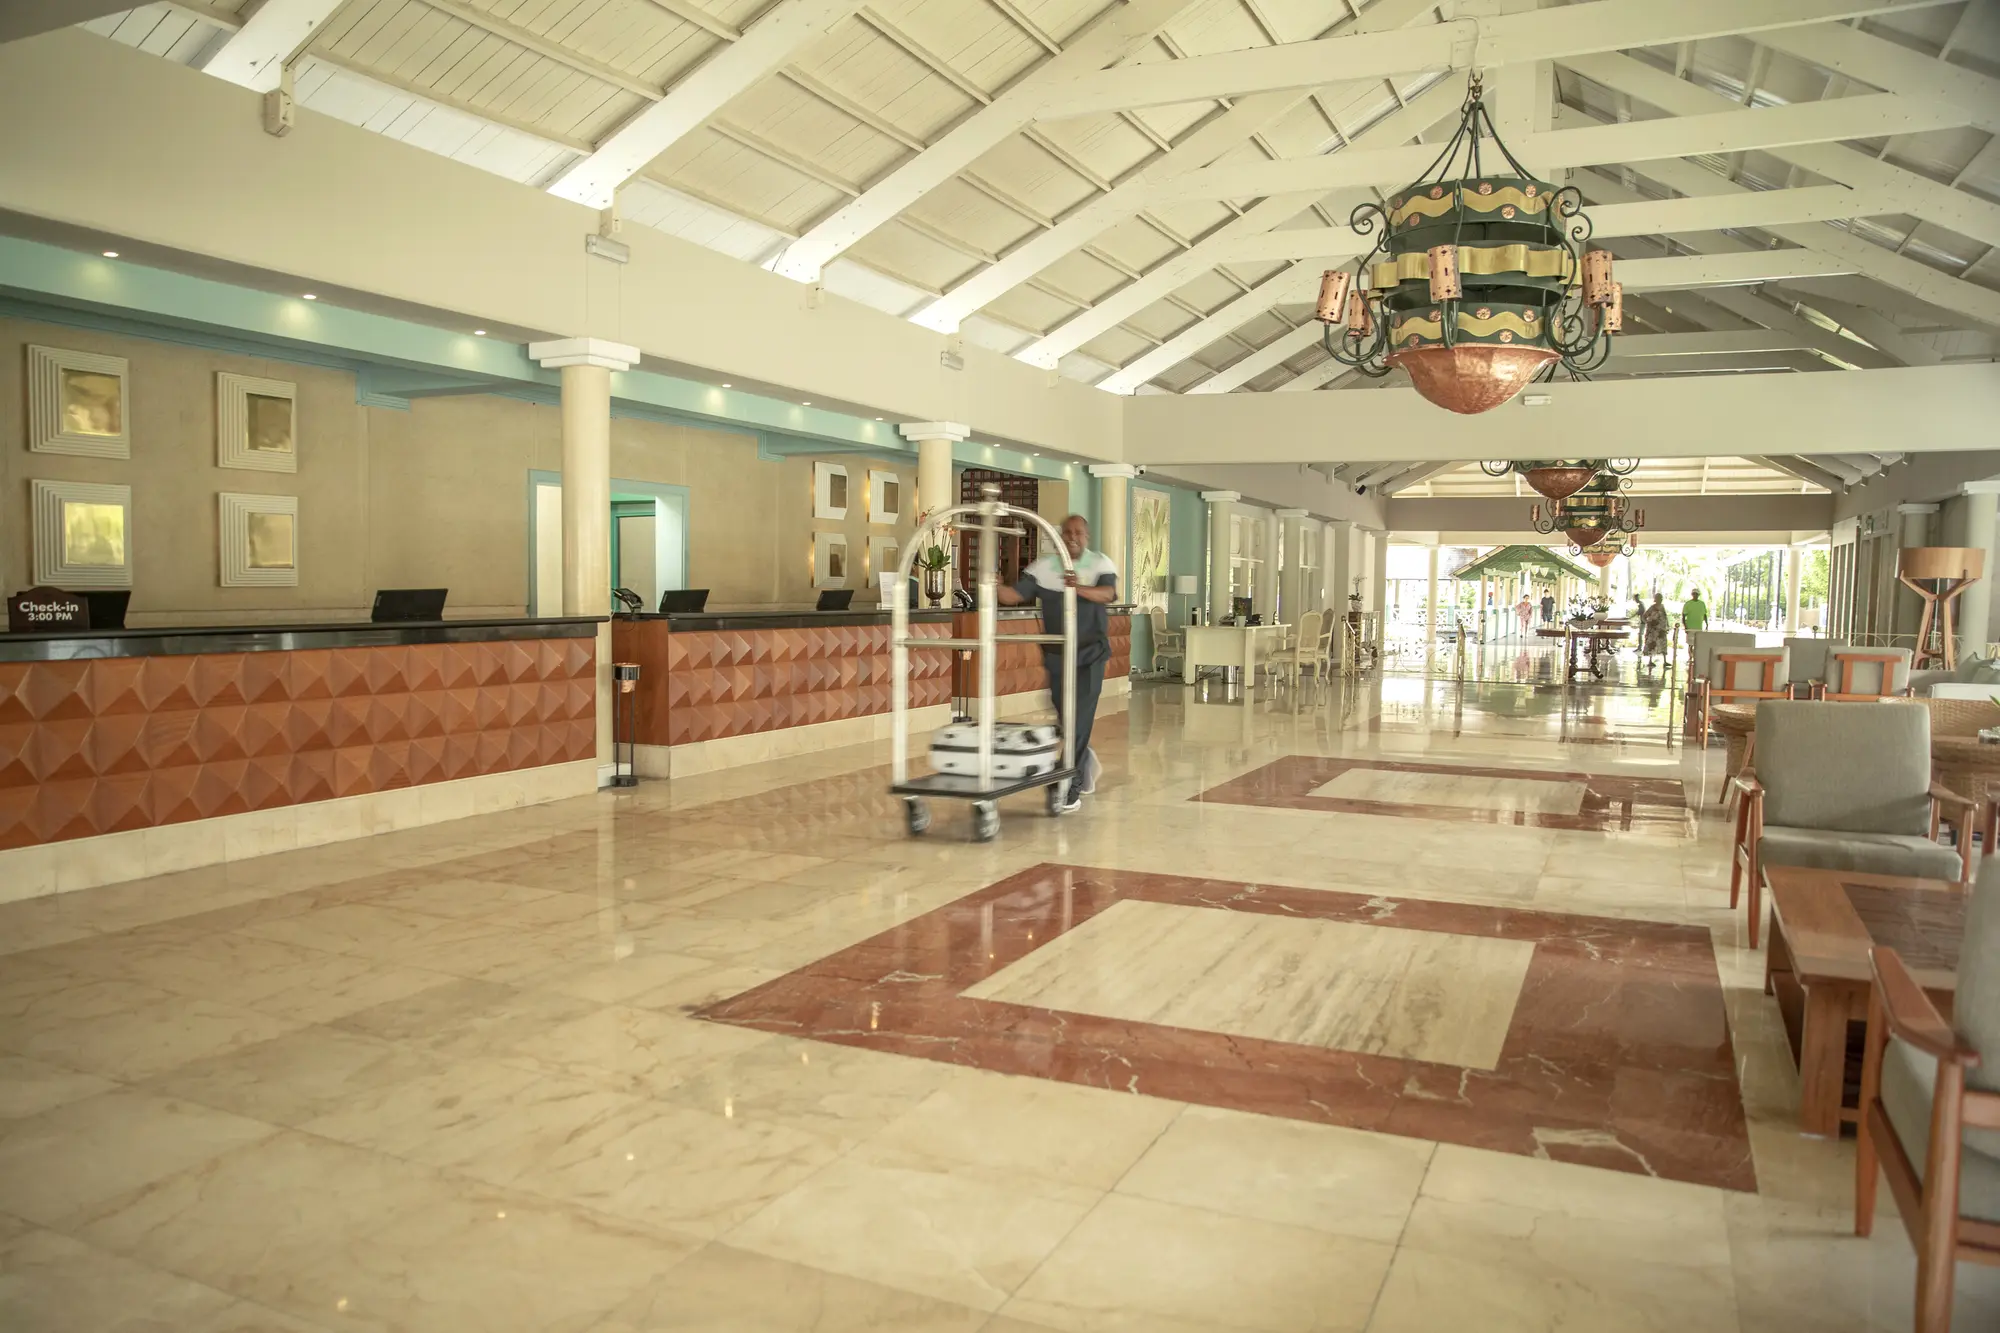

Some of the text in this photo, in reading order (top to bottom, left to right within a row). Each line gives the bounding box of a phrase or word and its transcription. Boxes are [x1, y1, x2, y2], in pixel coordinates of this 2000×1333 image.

[19, 601, 79, 612] Check-in
[28, 613, 72, 621] 3:00 PM
